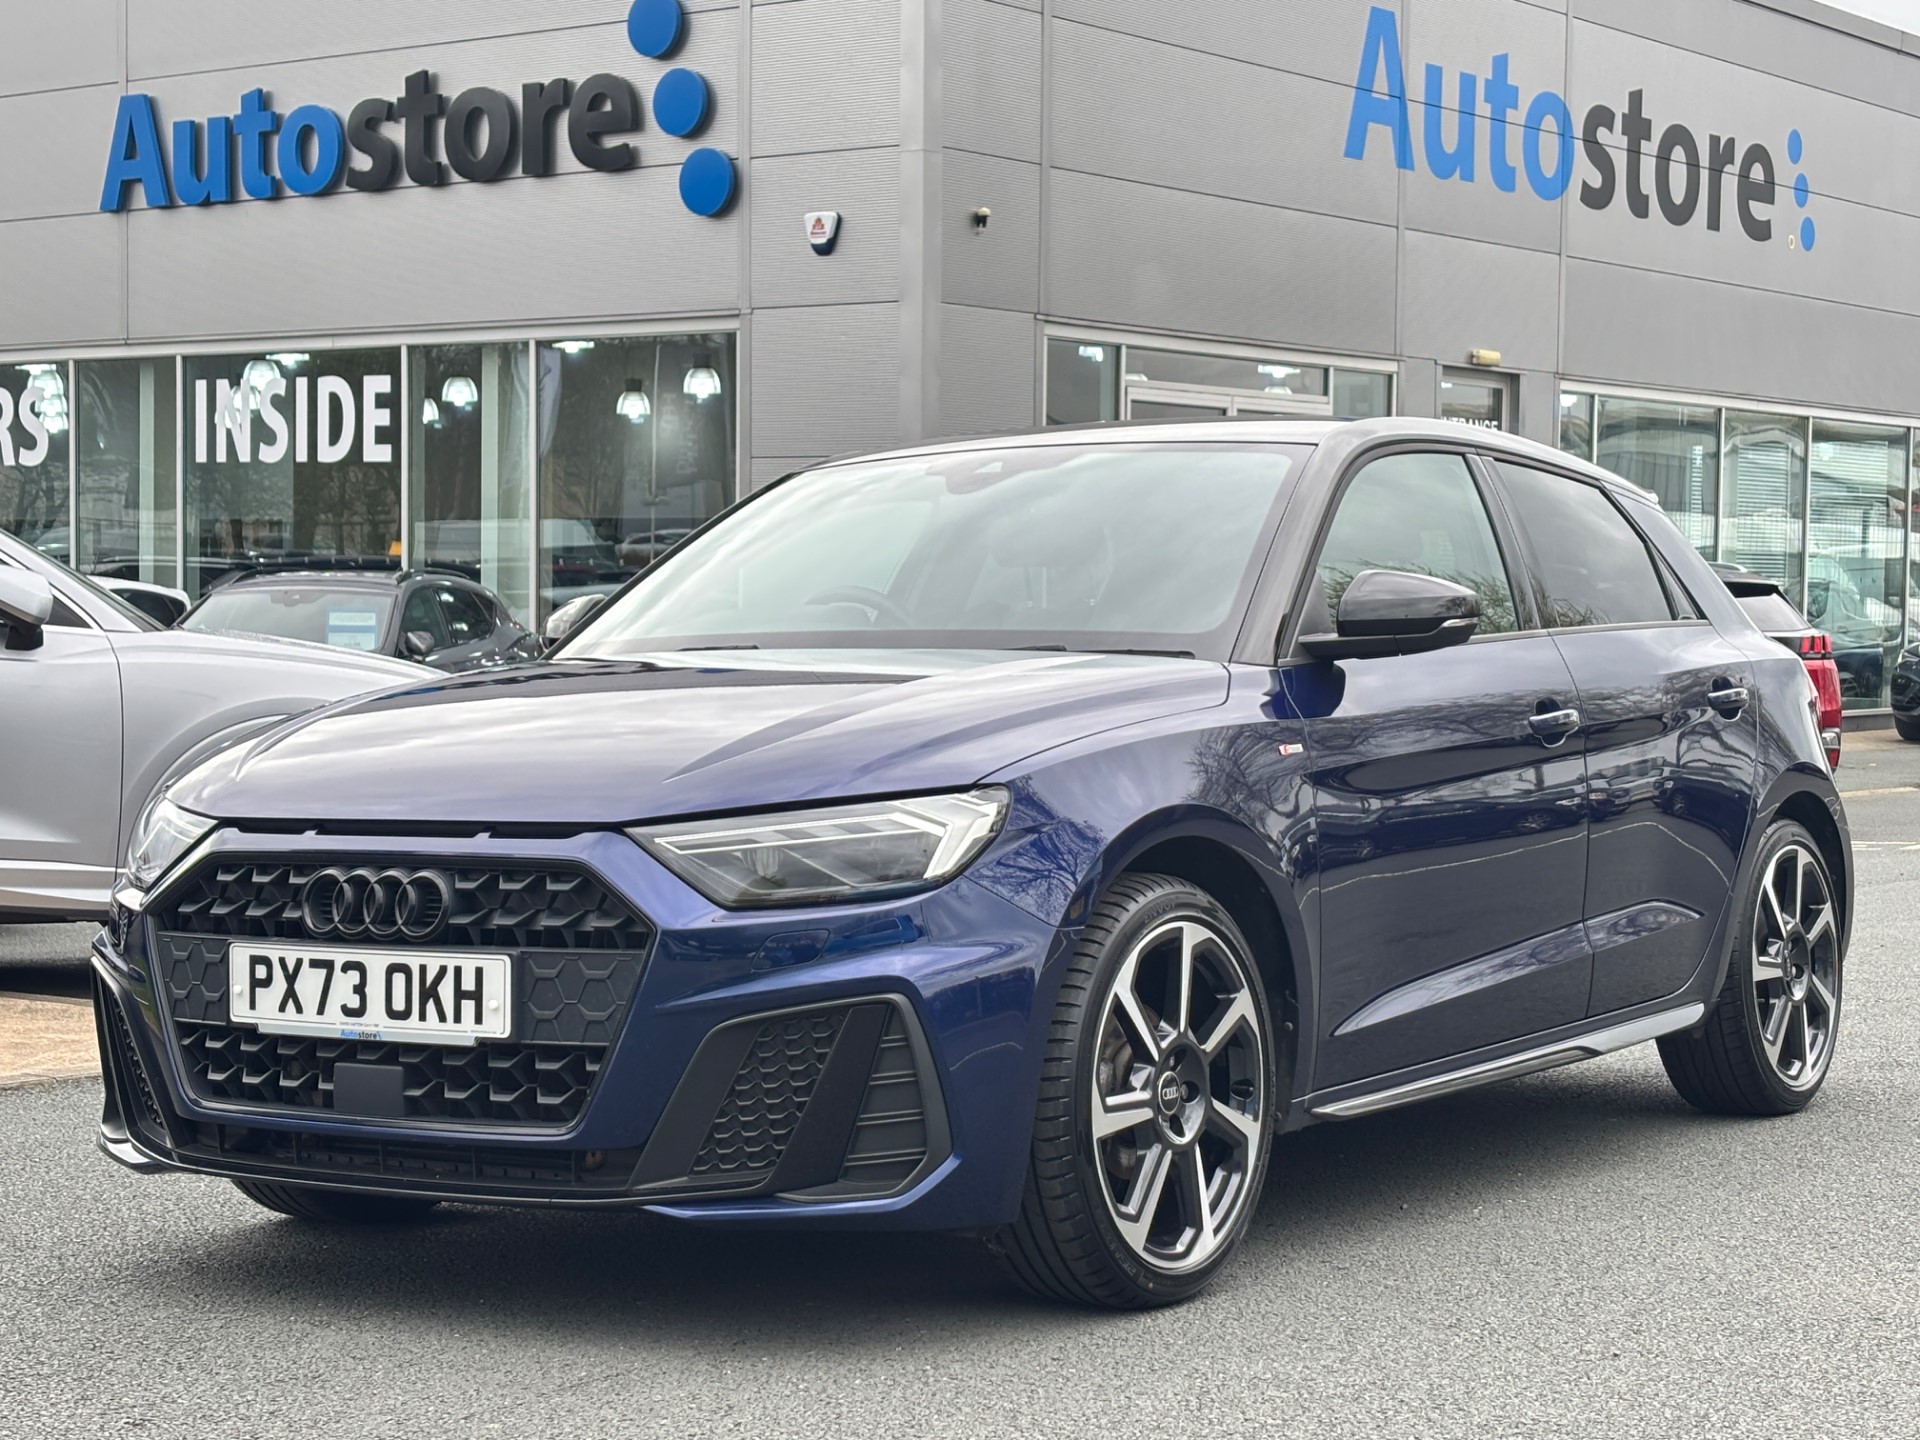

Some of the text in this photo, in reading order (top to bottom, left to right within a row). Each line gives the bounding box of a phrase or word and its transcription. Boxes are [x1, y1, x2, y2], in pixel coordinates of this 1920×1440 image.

[99, 69, 640, 212] Autostore
[1343, 5, 1776, 243] Autostore
[195, 374, 393, 464] INSIDE
[248, 954, 484, 1026] PX73 OKH
[340, 1029, 377, 1040] Autostore
